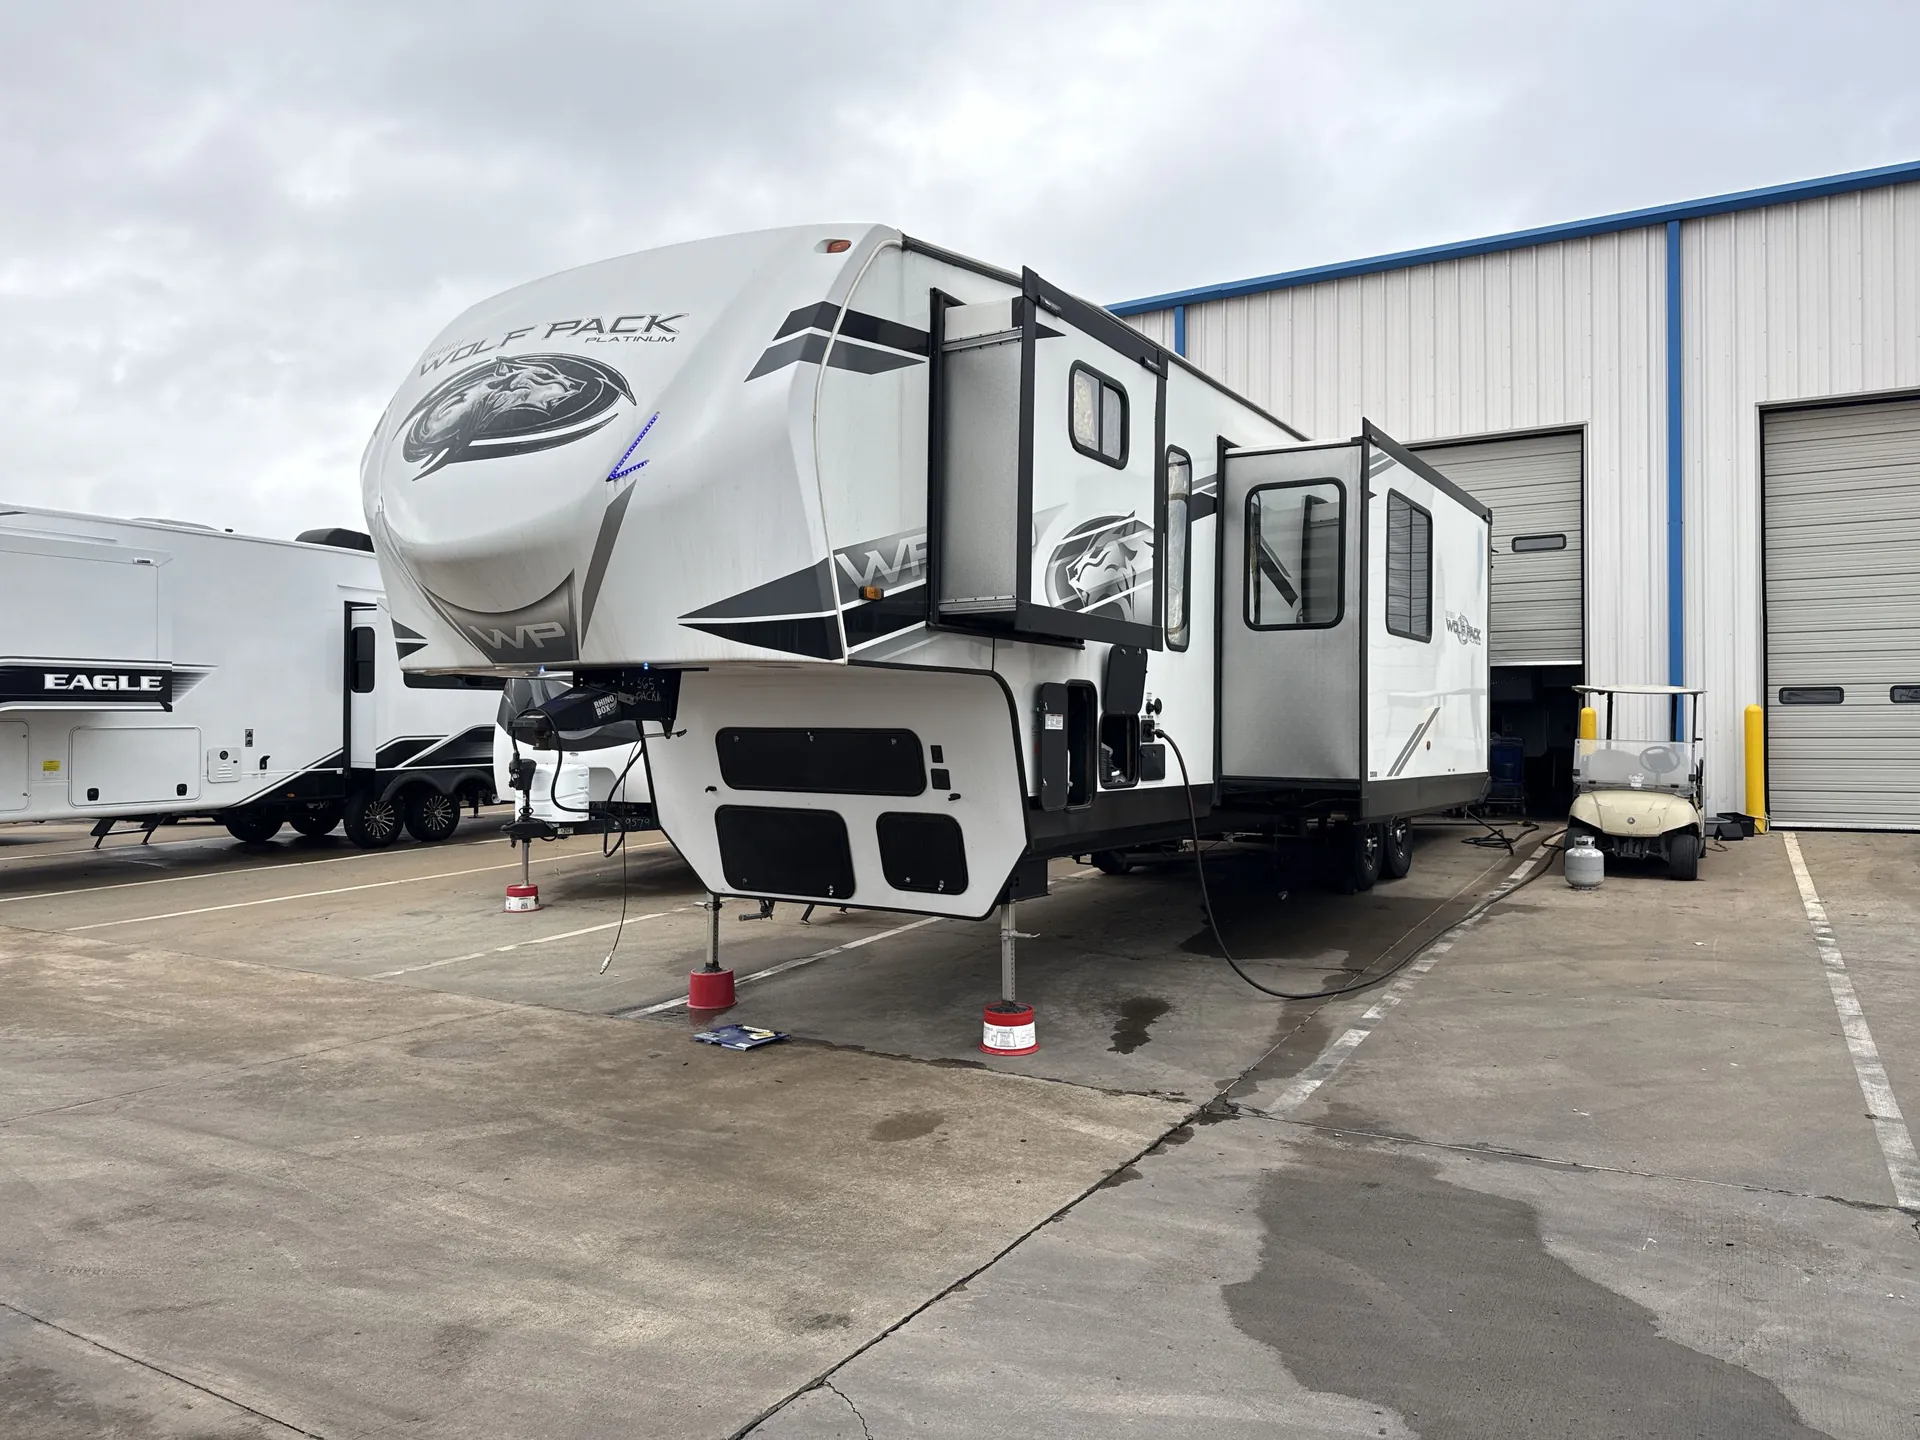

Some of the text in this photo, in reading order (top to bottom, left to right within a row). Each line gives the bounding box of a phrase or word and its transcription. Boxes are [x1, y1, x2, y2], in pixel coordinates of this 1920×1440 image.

[419, 324, 537, 377] WOLF
[542, 313, 689, 340] PACK
[585, 335, 676, 343] PLATINUM
[468, 621, 565, 649] WP
[43, 673, 163, 691] EAGLE
[594, 695, 614, 709] RHINO
[596, 704, 610, 715] BOX
[625, 818, 650, 829] 9579
